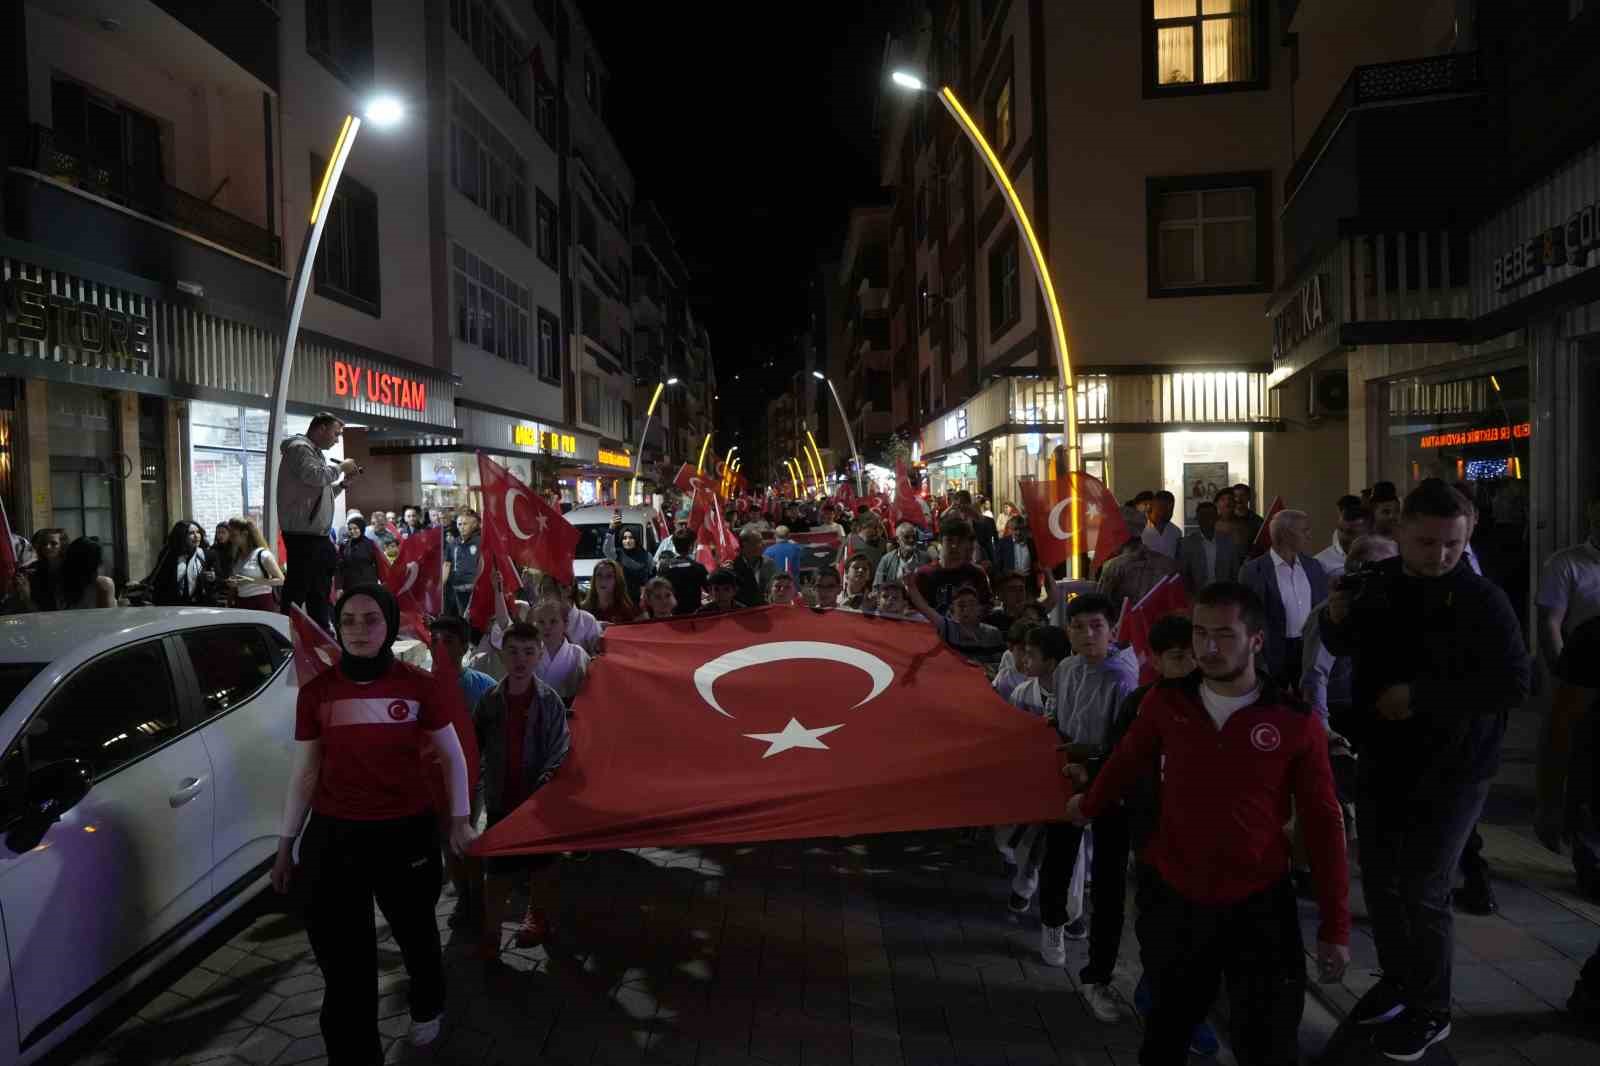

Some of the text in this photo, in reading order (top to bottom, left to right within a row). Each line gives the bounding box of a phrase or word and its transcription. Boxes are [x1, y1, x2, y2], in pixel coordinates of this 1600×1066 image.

[1494, 240, 1536, 290] BEBE
[16, 278, 150, 360] STORE
[334, 361, 425, 412] BY USTAM
